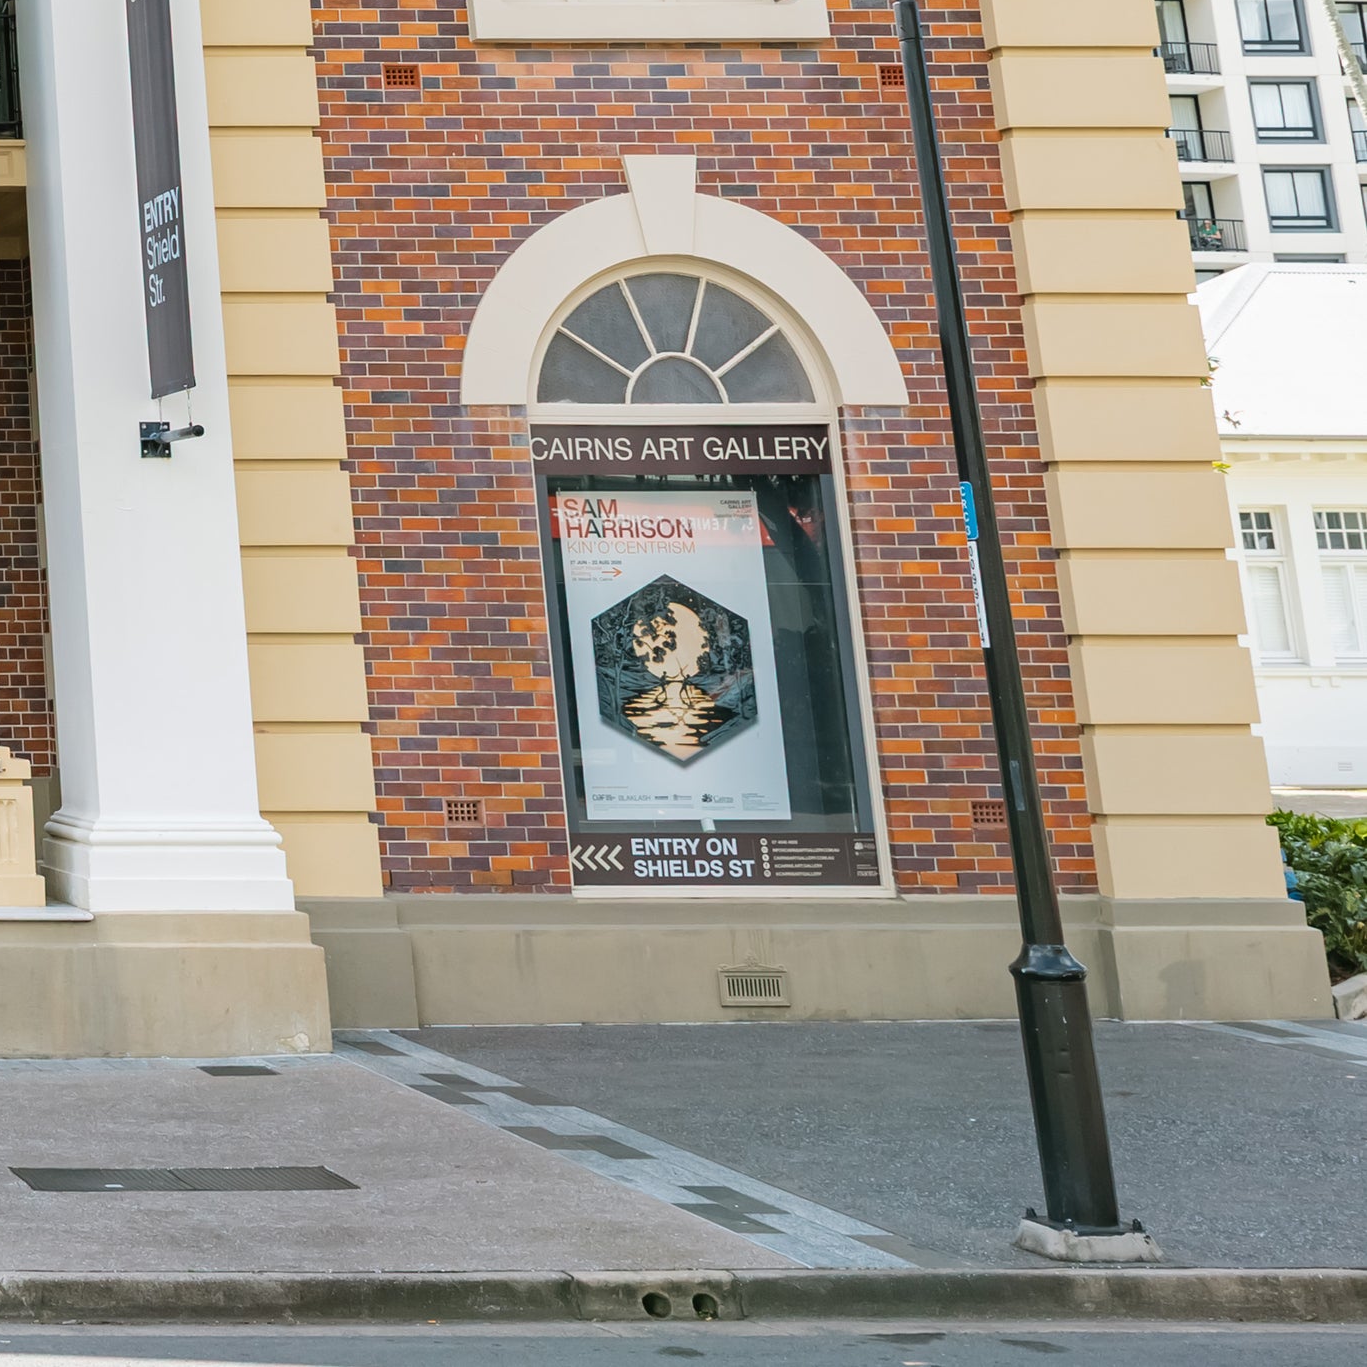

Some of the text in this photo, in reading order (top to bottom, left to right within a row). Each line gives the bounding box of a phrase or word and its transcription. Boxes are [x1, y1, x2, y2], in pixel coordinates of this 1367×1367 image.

[143, 186, 179, 234] ENTRY
[146, 225, 181, 270] Shield
[148, 273, 166, 307] Str.
[531, 437, 828, 461] CAIRNS ART GALLERY
[563, 498, 617, 518] SAM
[567, 519, 693, 538] HARRISON
[630, 838, 738, 856] ENTRY ON
[634, 859, 755, 878] SHIELDS ST
